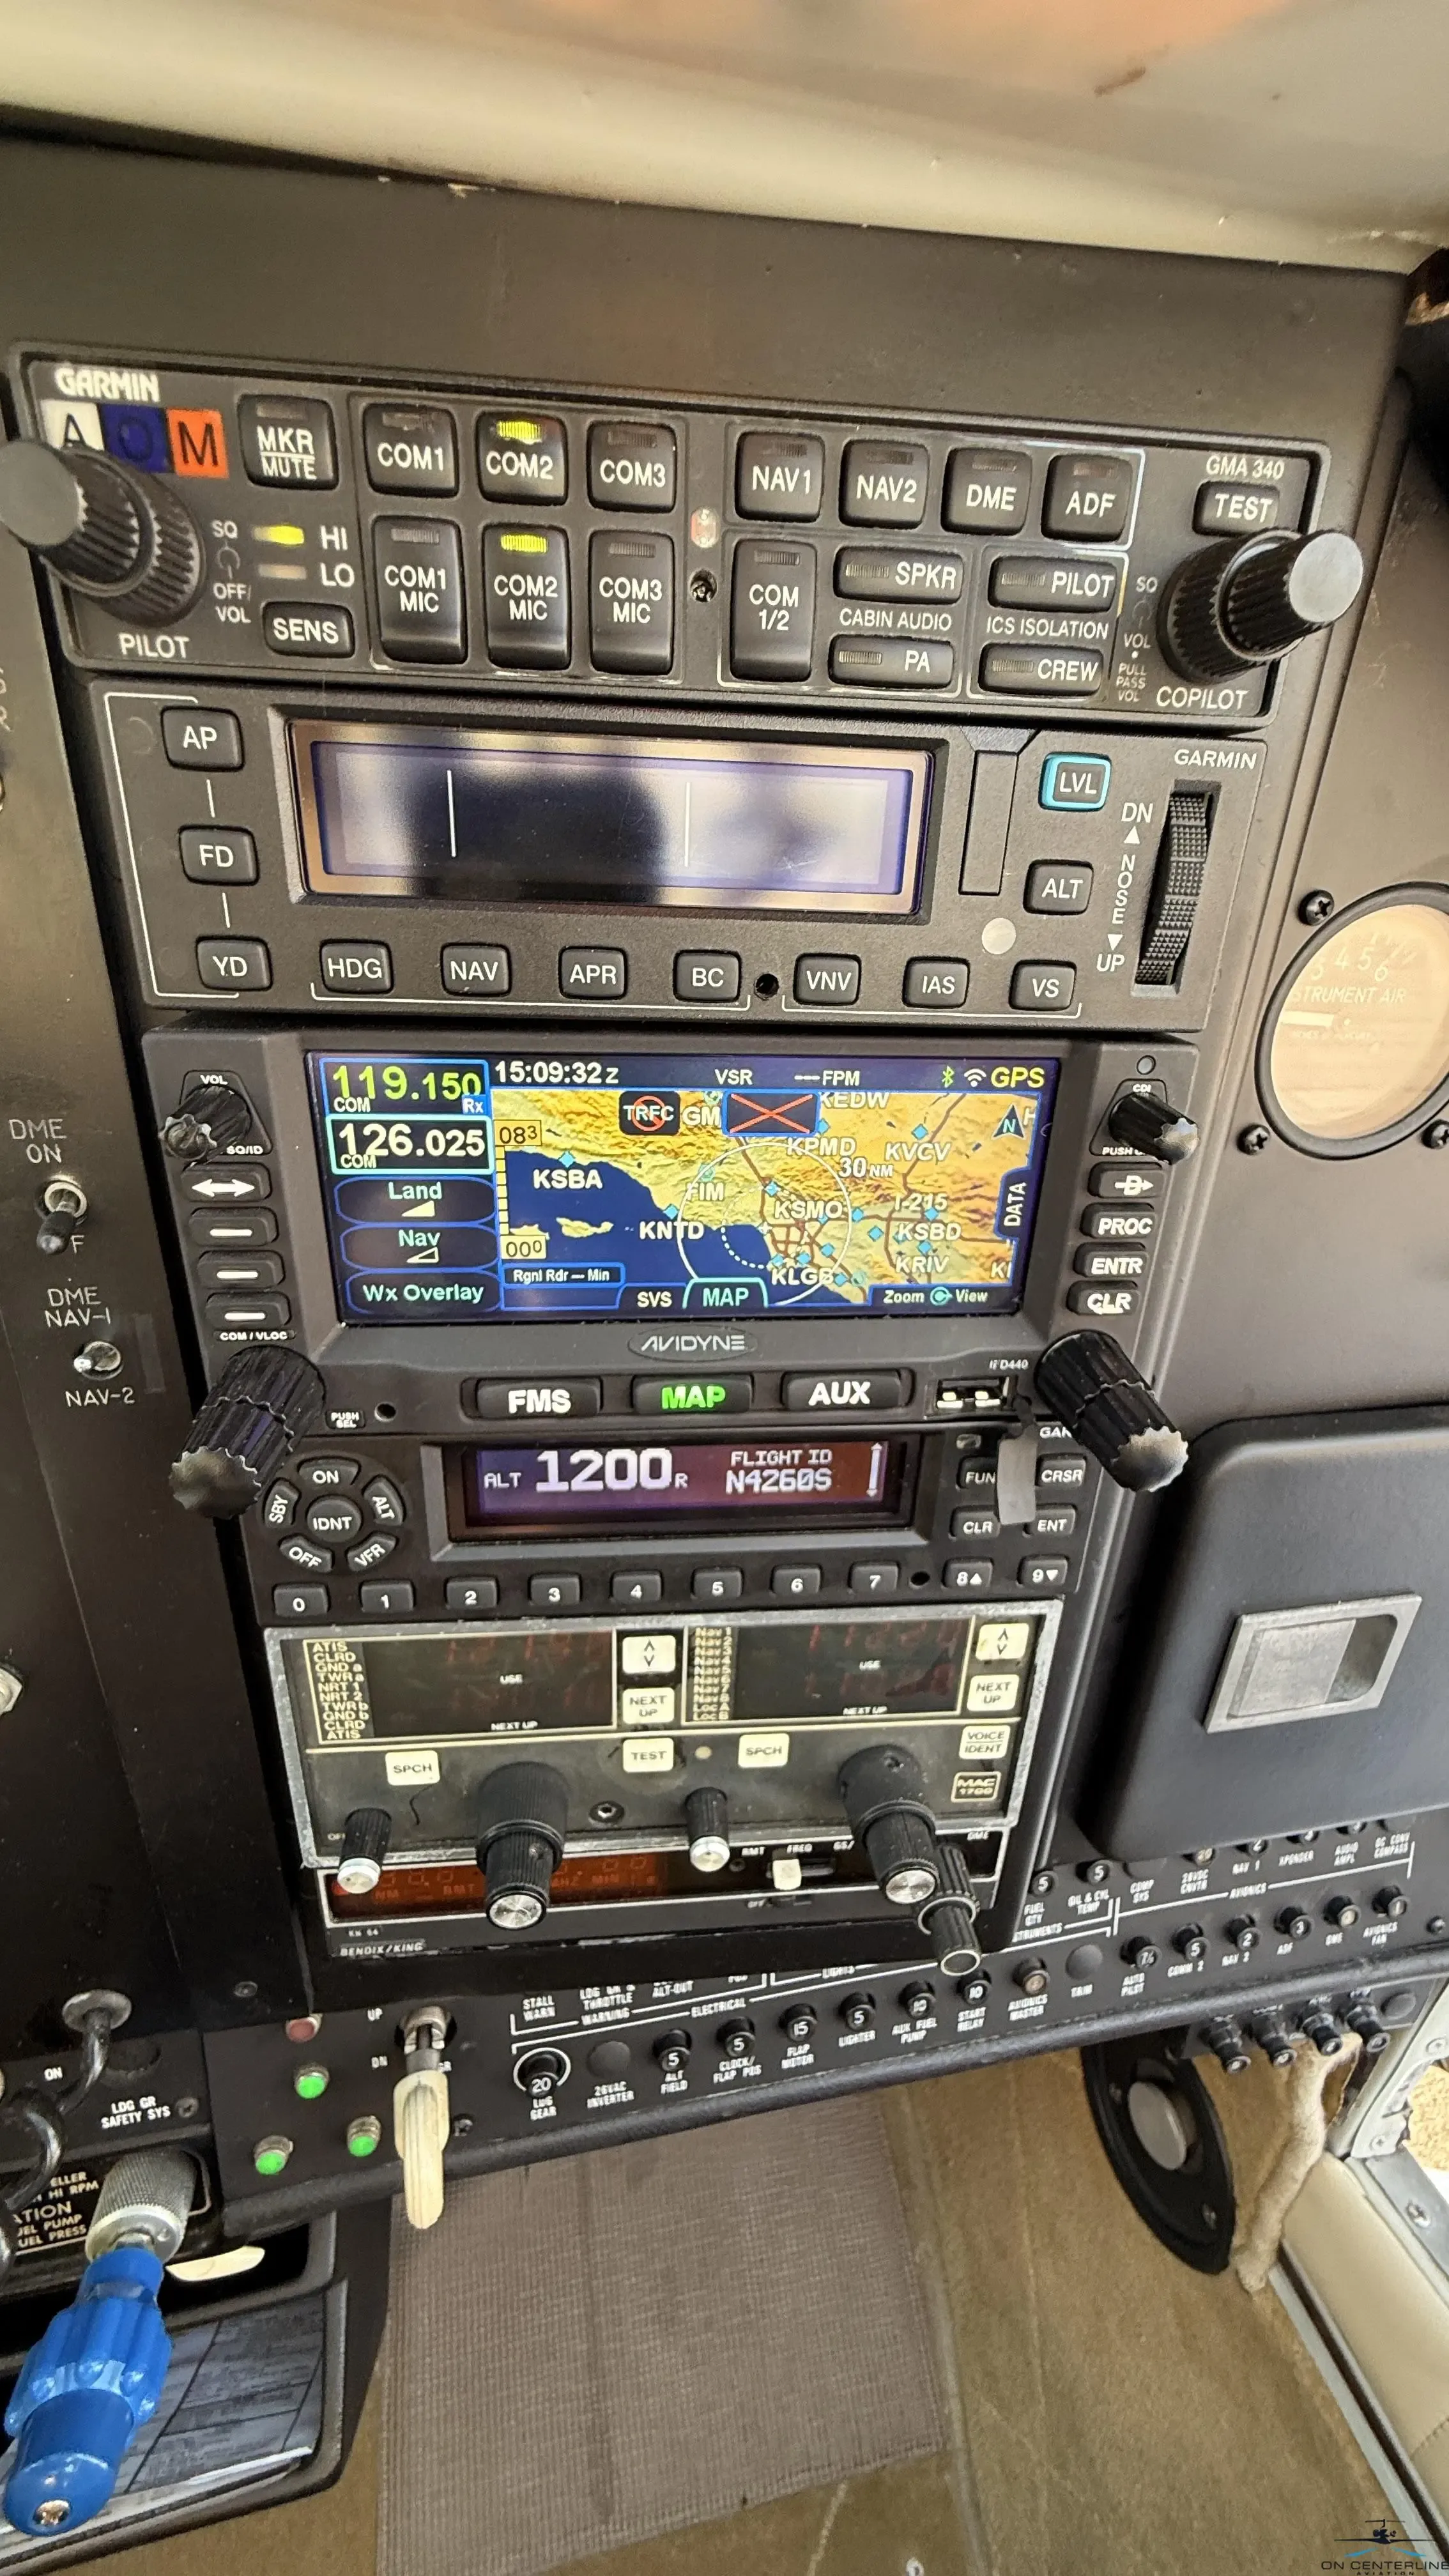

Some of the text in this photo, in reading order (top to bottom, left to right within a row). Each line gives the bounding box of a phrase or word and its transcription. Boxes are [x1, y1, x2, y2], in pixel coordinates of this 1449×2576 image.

[54, 368, 160, 401] GARMIN
[179, 420, 219, 468] M
[257, 425, 315, 454] MKR
[377, 443, 444, 471] COM1
[486, 452, 553, 480] COM2
[261, 457, 317, 480] MUTE
[600, 459, 666, 487] COM3
[1206, 456, 1285, 480] GMA 340
[751, 466, 811, 494] NAV1
[856, 475, 917, 503] NAV2
[967, 484, 1016, 511] DME
[1066, 490, 1116, 518] ADF
[1213, 493, 1273, 523] TEST
[211, 521, 238, 539] SQ
[321, 526, 348, 550] HI
[321, 564, 355, 587] LO
[385, 565, 446, 590] COM1
[896, 562, 957, 590] SPKR
[1052, 571, 1114, 599] PILOT
[494, 575, 558, 599] COM2
[599, 577, 663, 601] COM3
[749, 585, 799, 608] COM
[400, 592, 440, 613] MIC
[509, 601, 548, 620] MIC
[215, 606, 251, 624] VOL
[613, 602, 651, 624] MIC
[760, 609, 790, 632] 1/2
[839, 608, 952, 632] CABIN AUDIO
[273, 618, 339, 644] SENS
[986, 615, 1108, 640] ICS ISOLATION
[119, 633, 189, 658] PILOT
[1124, 632, 1151, 648] VOL
[905, 650, 931, 673] PA
[1118, 663, 1147, 676] PULL
[1038, 661, 1098, 682] CREW
[1116, 676, 1146, 689] PASS
[1117, 689, 1140, 702] VOL
[1156, 687, 1248, 710] COPILOT
[183, 726, 217, 750] AP
[1174, 749, 1257, 770] GARMIN
[1059, 773, 1098, 794] LVL
[1121, 802, 1153, 824] DN
[199, 845, 234, 868] FD
[1043, 879, 1083, 900] ALT
[1112, 854, 1135, 925] NOSE
[213, 956, 247, 977] YD
[328, 958, 382, 979] HDG
[451, 961, 498, 981] NAV
[1096, 953, 1125, 974] UP
[570, 965, 617, 985] APR
[692, 968, 724, 987] BC
[806, 971, 852, 992] VNV
[921, 976, 955, 995] IAS
[1031, 979, 1060, 998] VS
[333, 1065, 481, 1102] 119.150
[715, 1070, 752, 1085] VSR
[991, 1067, 1045, 1087] GPS
[334, 1097, 371, 1112] COM
[463, 1098, 484, 1114] Rx
[624, 1105, 675, 1121] TRFC
[9, 1119, 67, 1139] DME
[339, 1123, 485, 1157] 126.025
[787, 1138, 855, 1156] KPMD
[26, 1144, 61, 1163] ON
[341, 1154, 376, 1169] COM
[885, 1143, 950, 1162] KVCV
[533, 1169, 602, 1190] KSBA
[389, 1181, 442, 1200] Land
[687, 1183, 724, 1200] FIM
[774, 1201, 843, 1219] KSMO
[895, 1193, 947, 1211] I-215
[1004, 1182, 1026, 1227] DATA
[640, 1222, 703, 1239] KNTD
[898, 1223, 962, 1240] KSBD
[1098, 1218, 1153, 1236] PROC
[399, 1230, 440, 1248] Nav
[896, 1257, 948, 1273] KRIV
[1091, 1257, 1143, 1275] ENTR
[513, 1269, 610, 1284] Rgnl Rdr Min
[772, 1268, 834, 1285] KLGB
[47, 1287, 101, 1307] DME
[363, 1284, 484, 1304] Wx Overlay
[637, 1291, 672, 1308] SVS
[703, 1287, 749, 1306] MAP
[883, 1290, 988, 1303] Zoom View
[641, 1335, 745, 1351] AVIDYNE
[65, 1388, 135, 1407] NAV-2
[509, 1389, 571, 1414] FMS
[661, 1384, 725, 1409] MAP
[808, 1381, 870, 1406] AUX
[731, 1450, 833, 1468] FLIGHT ID
[312, 1471, 338, 1483] ON
[484, 1448, 688, 1492] ALT 1200 R
[1041, 1469, 1083, 1483] CRSR
[725, 1469, 832, 1495] N4260S
[312, 1517, 352, 1530] IDNT
[963, 1521, 992, 1534] CLR
[1038, 1518, 1065, 1532] ENT
[312, 1641, 348, 1653] ATIS
[314, 1652, 356, 1662] CLRD
[859, 1660, 881, 1671] USE
[318, 1682, 360, 1692] NRT 1
[500, 1674, 523, 1685] USE
[976, 1682, 1011, 1692] NEXT
[319, 1691, 363, 1701] NRT 2
[630, 1696, 666, 1706] NEXT
[984, 1695, 1001, 1704] UP
[639, 1709, 657, 1717] UP
[324, 1720, 365, 1731] CLRD
[327, 1729, 361, 1740] ATIS
[491, 1721, 538, 1731] NEXT UP
[967, 1731, 1004, 1740] VOICE
[631, 1751, 666, 1761] TEST
[746, 1745, 783, 1756] SPCH
[964, 1744, 1001, 1753] IDENT
[394, 1763, 432, 1774] SPCH
[1024, 1902, 1045, 1915] FUEL
[341, 1942, 422, 1957] BENDIX/KING
[523, 1995, 555, 2009] STALL
[367, 2007, 383, 2021] UP
[793, 2022, 808, 2035] 15
[44, 2067, 62, 2080] ON
[532, 2076, 551, 2092] 20
[112, 2100, 135, 2114] LDG
[101, 2106, 170, 2128] SAFETY SYS
[49, 2188, 63, 2199] HI
[69, 2180, 99, 2195] RPM
[44, 2214, 82, 2230] PUMP
[49, 2225, 86, 2241] PRESS
